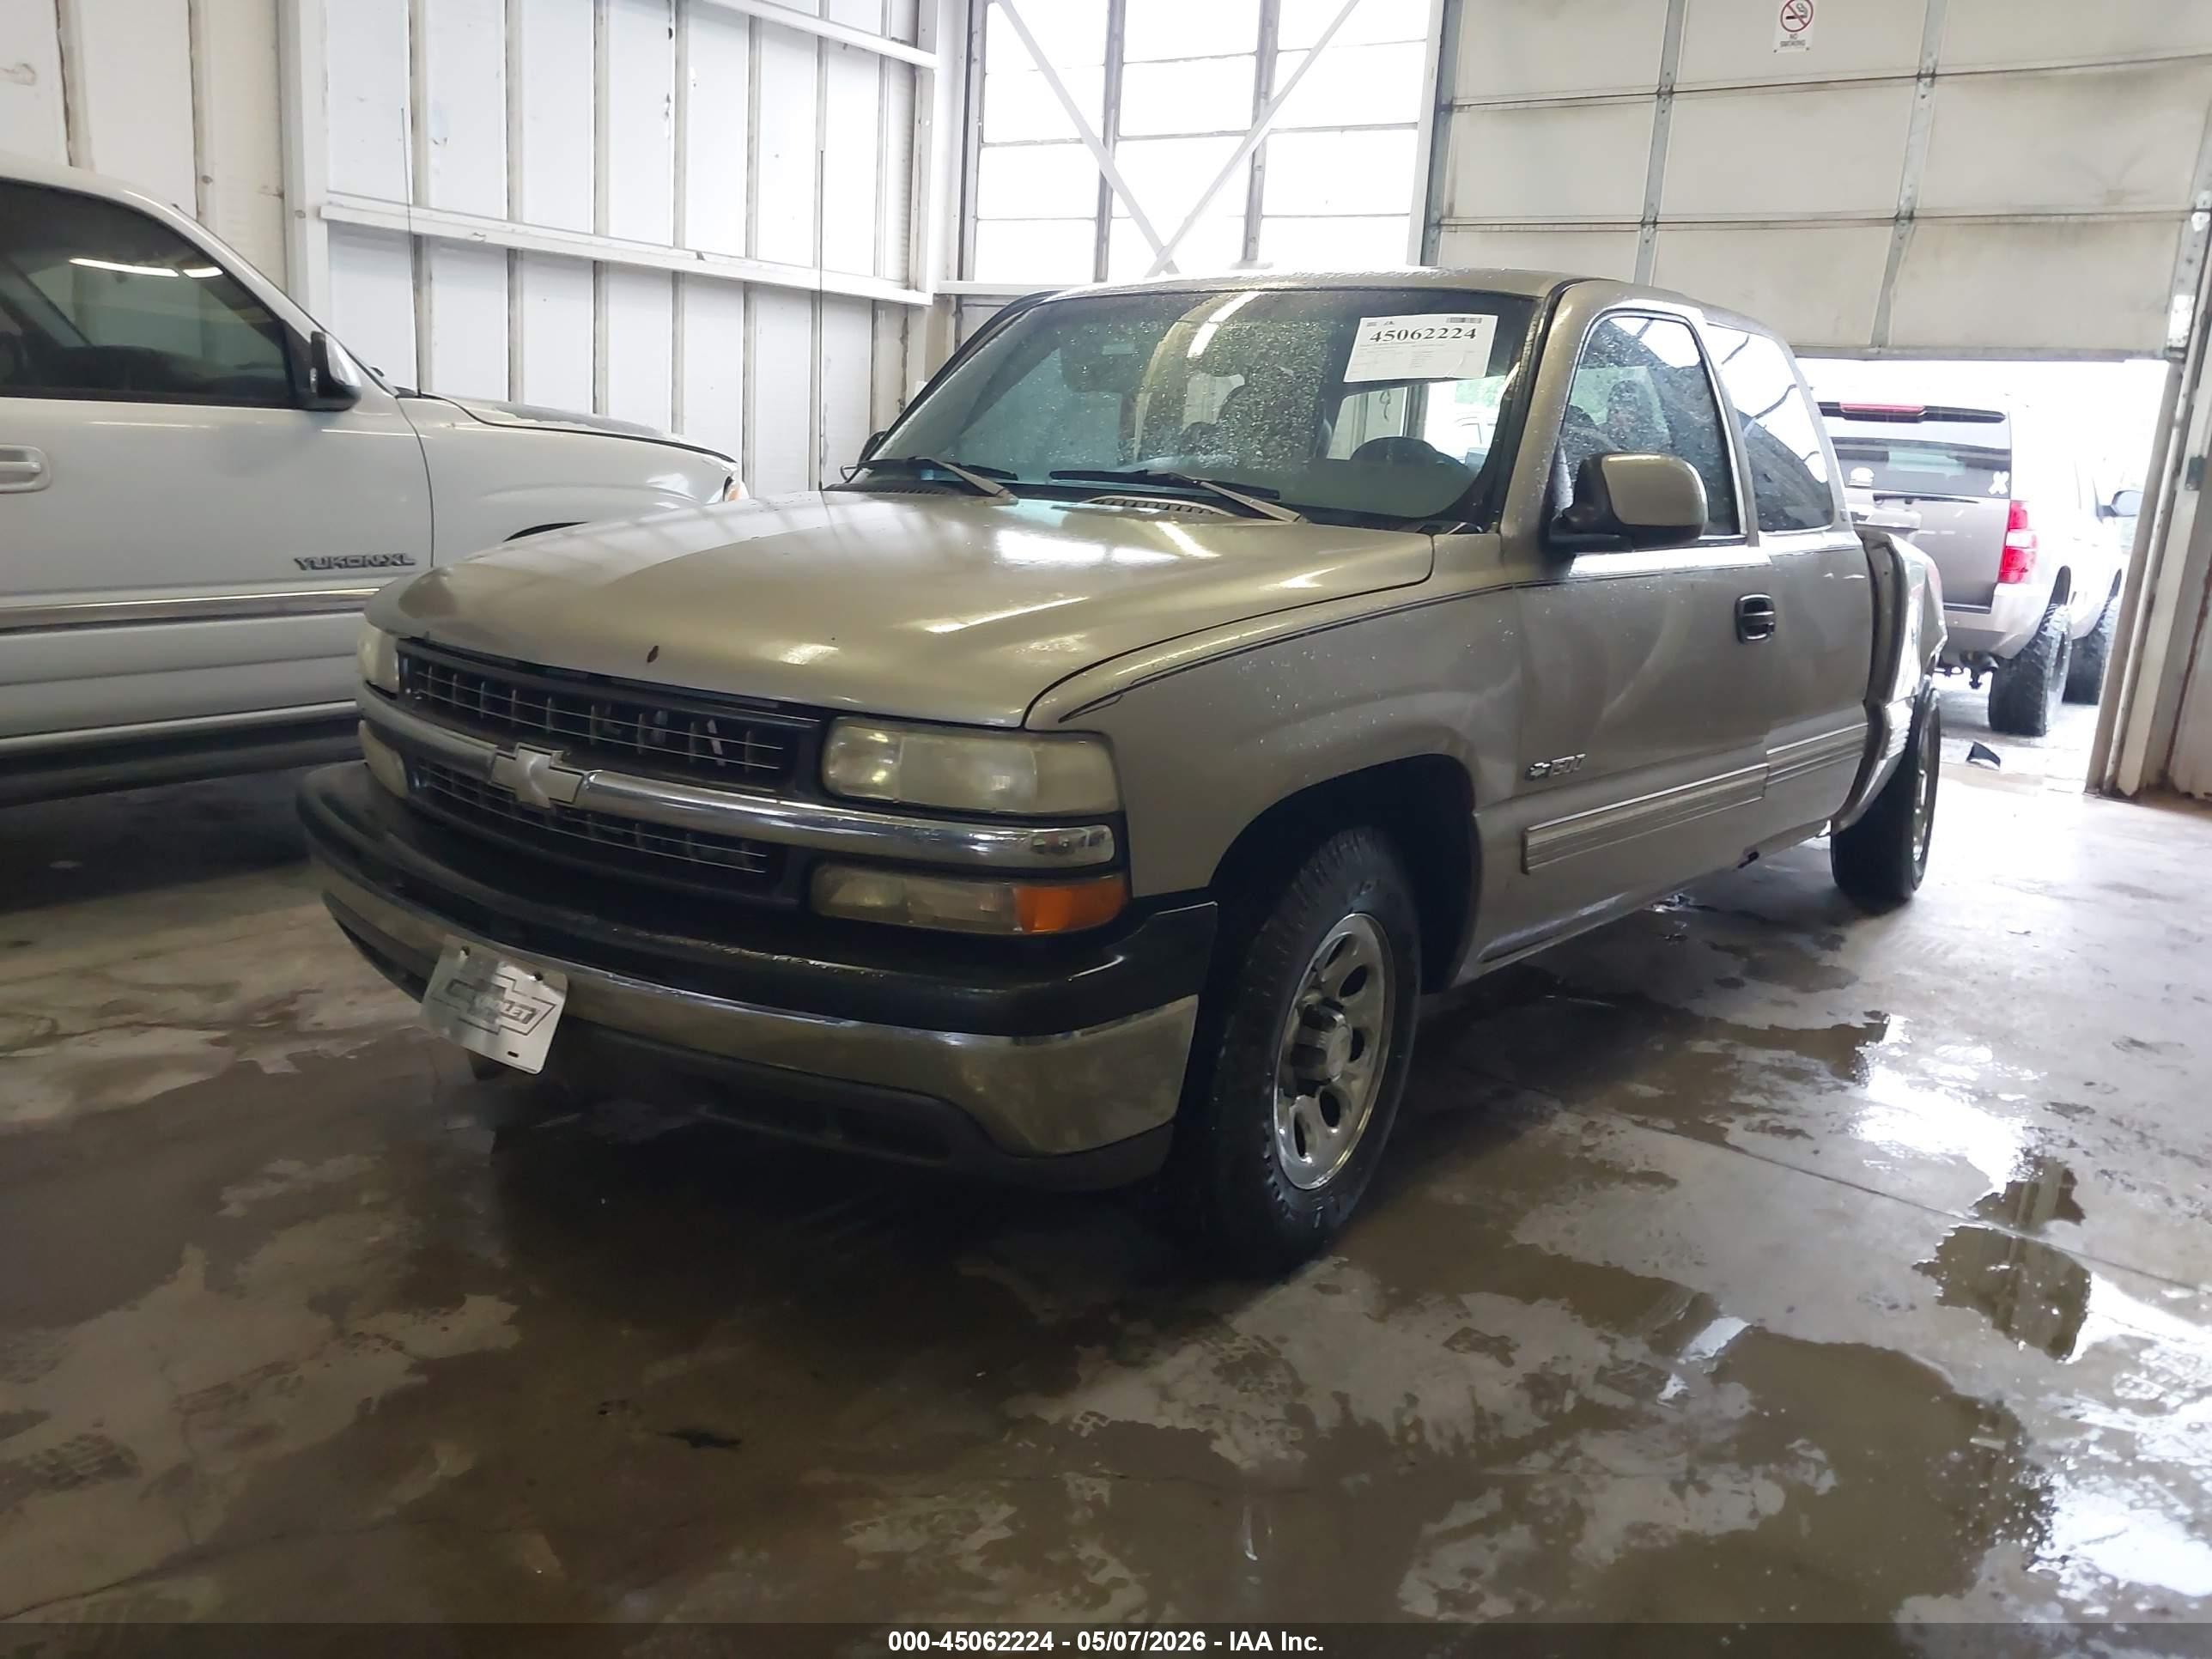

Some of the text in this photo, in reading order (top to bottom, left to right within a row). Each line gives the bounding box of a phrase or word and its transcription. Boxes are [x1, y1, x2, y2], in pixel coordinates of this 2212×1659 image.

[1370, 327, 1476, 343] 45062224
[294, 552, 416, 571] YUKON XL
